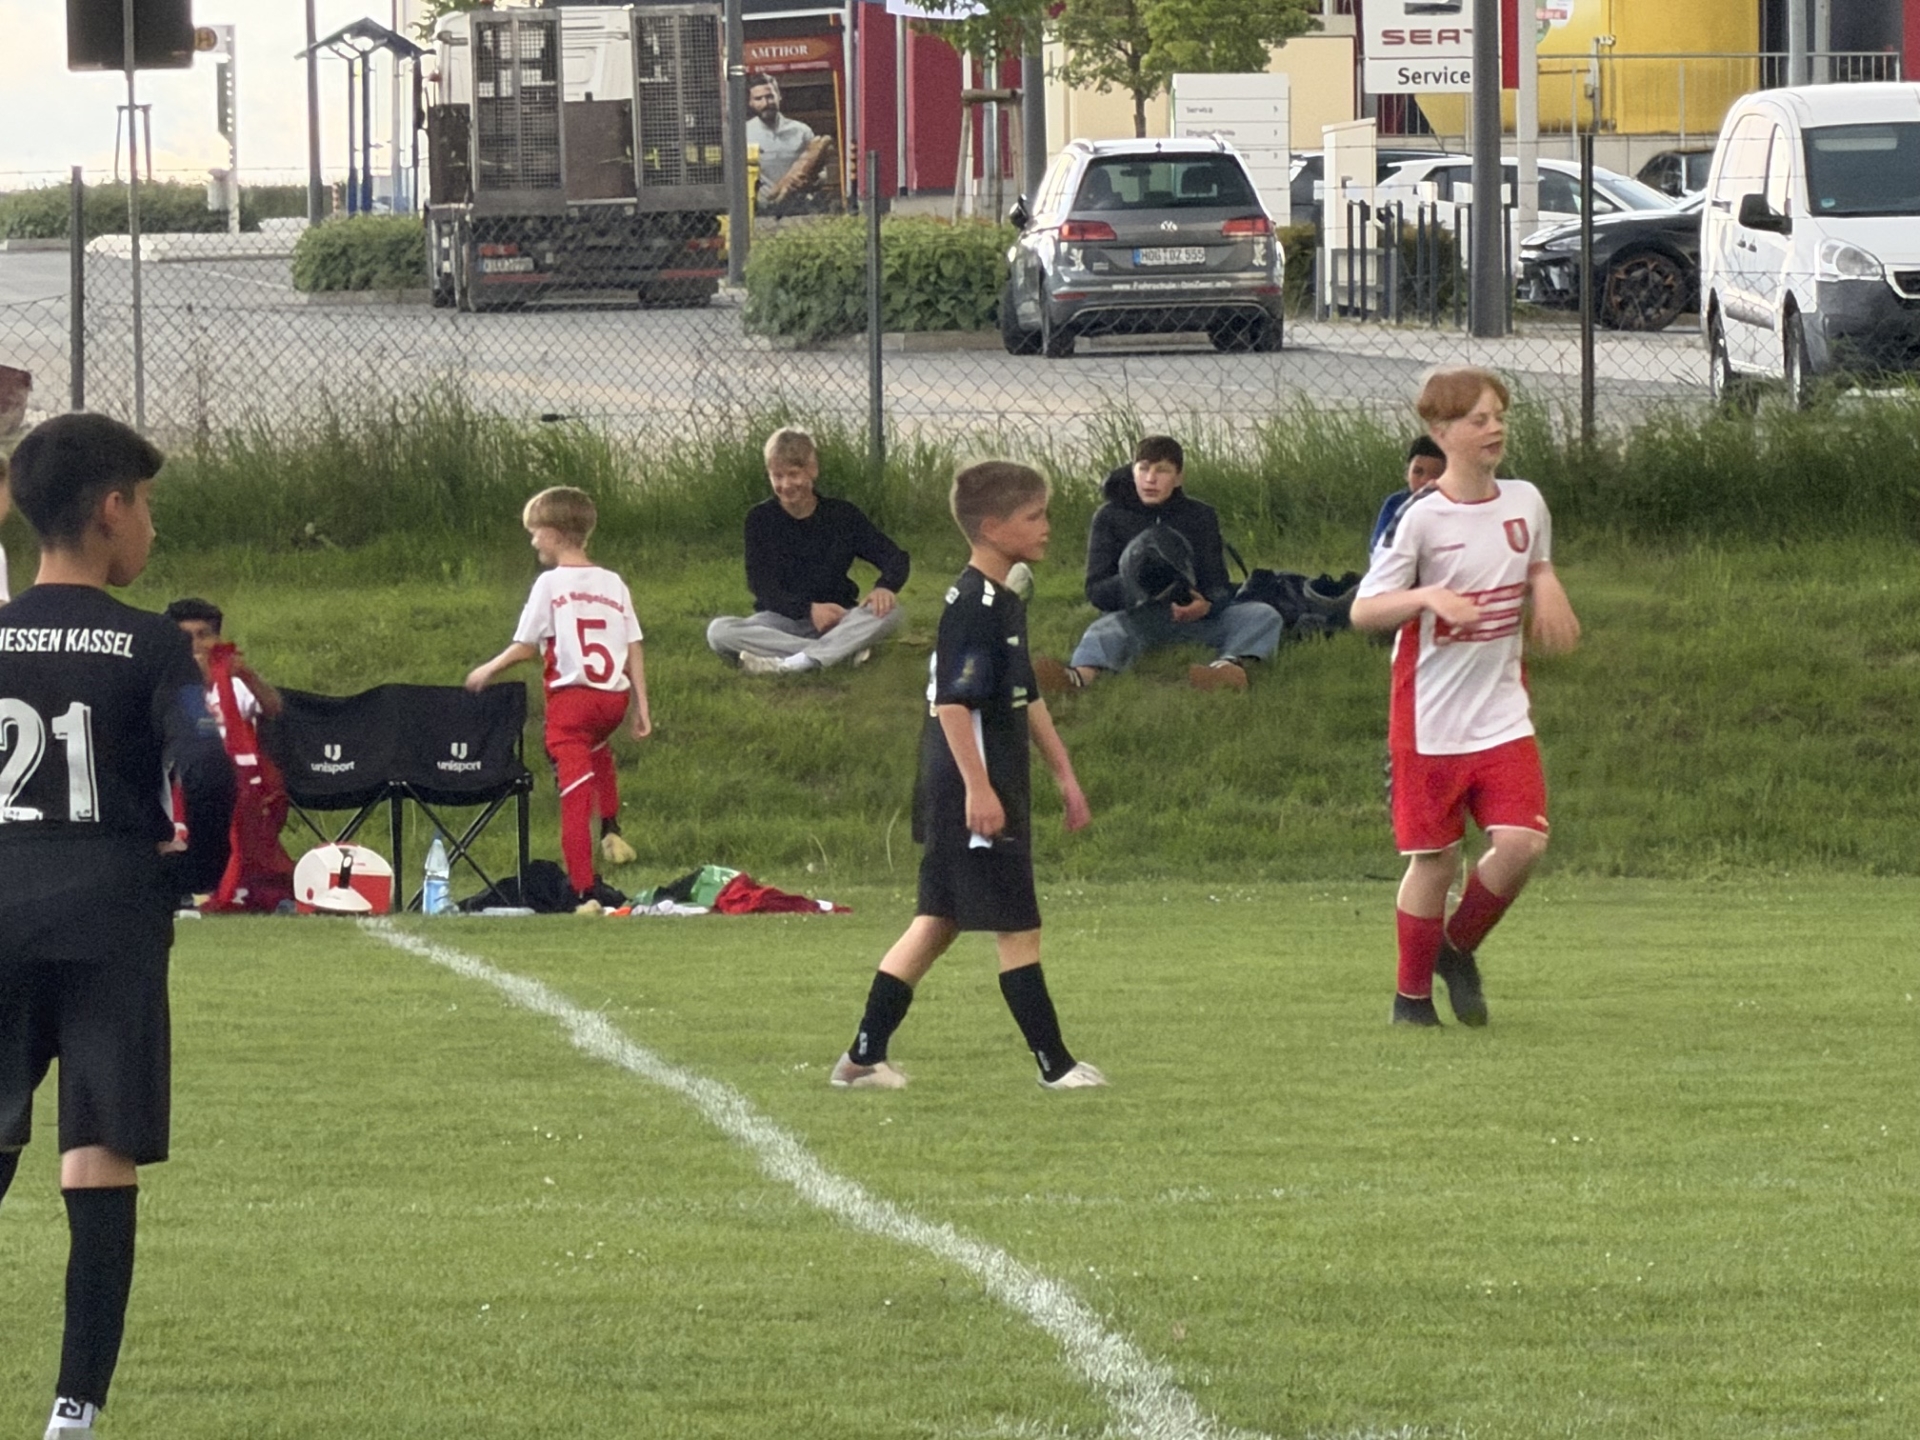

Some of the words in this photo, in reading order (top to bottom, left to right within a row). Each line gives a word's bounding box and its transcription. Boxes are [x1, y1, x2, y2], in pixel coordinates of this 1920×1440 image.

[1381, 28, 1474, 46] SEA
[750, 44, 809, 59] AMTHOR
[1397, 66, 1471, 85] Service
[65, 628, 133, 658] KASSEL
[576, 617, 615, 684] 5
[0, 697, 100, 823] 21
[310, 761, 355, 775] unisport
[437, 760, 481, 773] unisport
